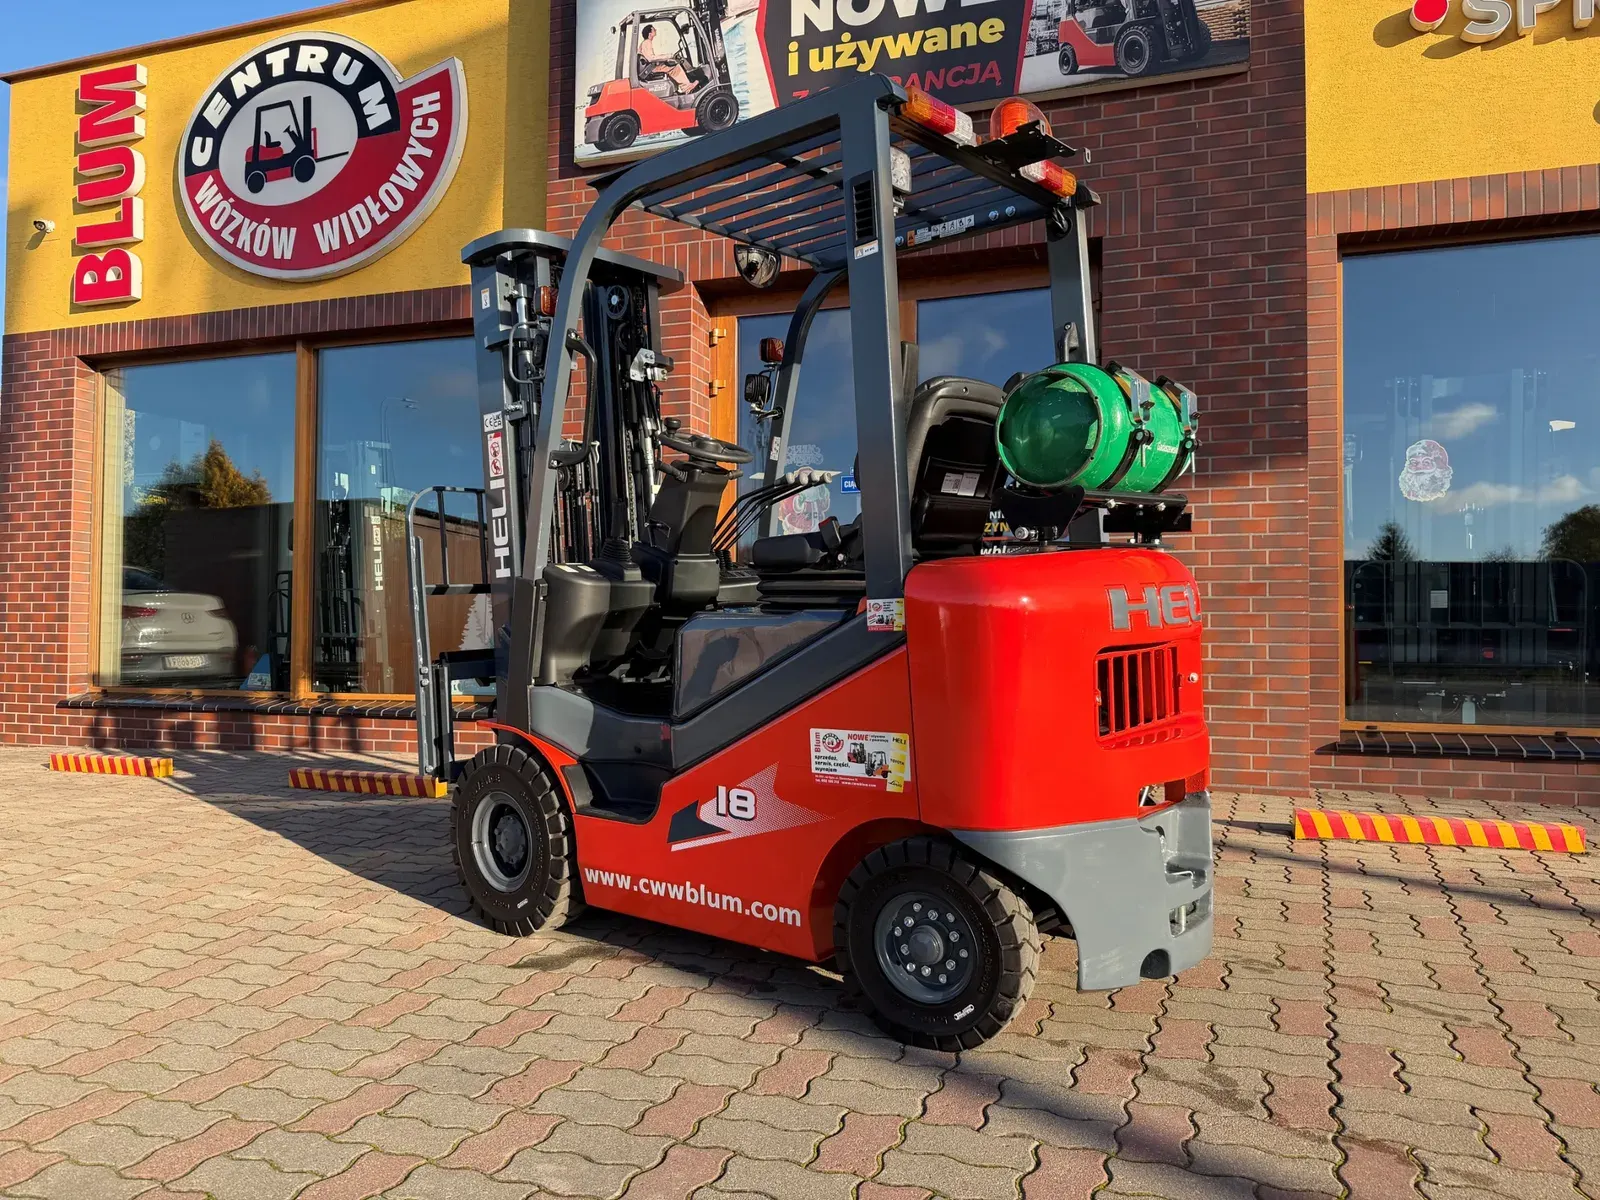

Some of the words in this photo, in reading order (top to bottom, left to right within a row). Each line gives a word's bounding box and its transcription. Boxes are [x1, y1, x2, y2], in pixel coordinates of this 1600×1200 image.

[788, 41, 799, 76] i
[809, 17, 1006, 72] używane
[192, 44, 393, 168] CENTRUM
[73, 63, 147, 304] BLUM
[194, 174, 298, 261] WÓZKÓW
[312, 90, 442, 255] WIDŁOWYCH
[490, 477, 512, 579] HELI
[373, 546, 384, 591] HELI
[847, 733, 869, 742] NOWE
[717, 785, 757, 821] 18
[584, 867, 802, 928] www.cwwblum.com
